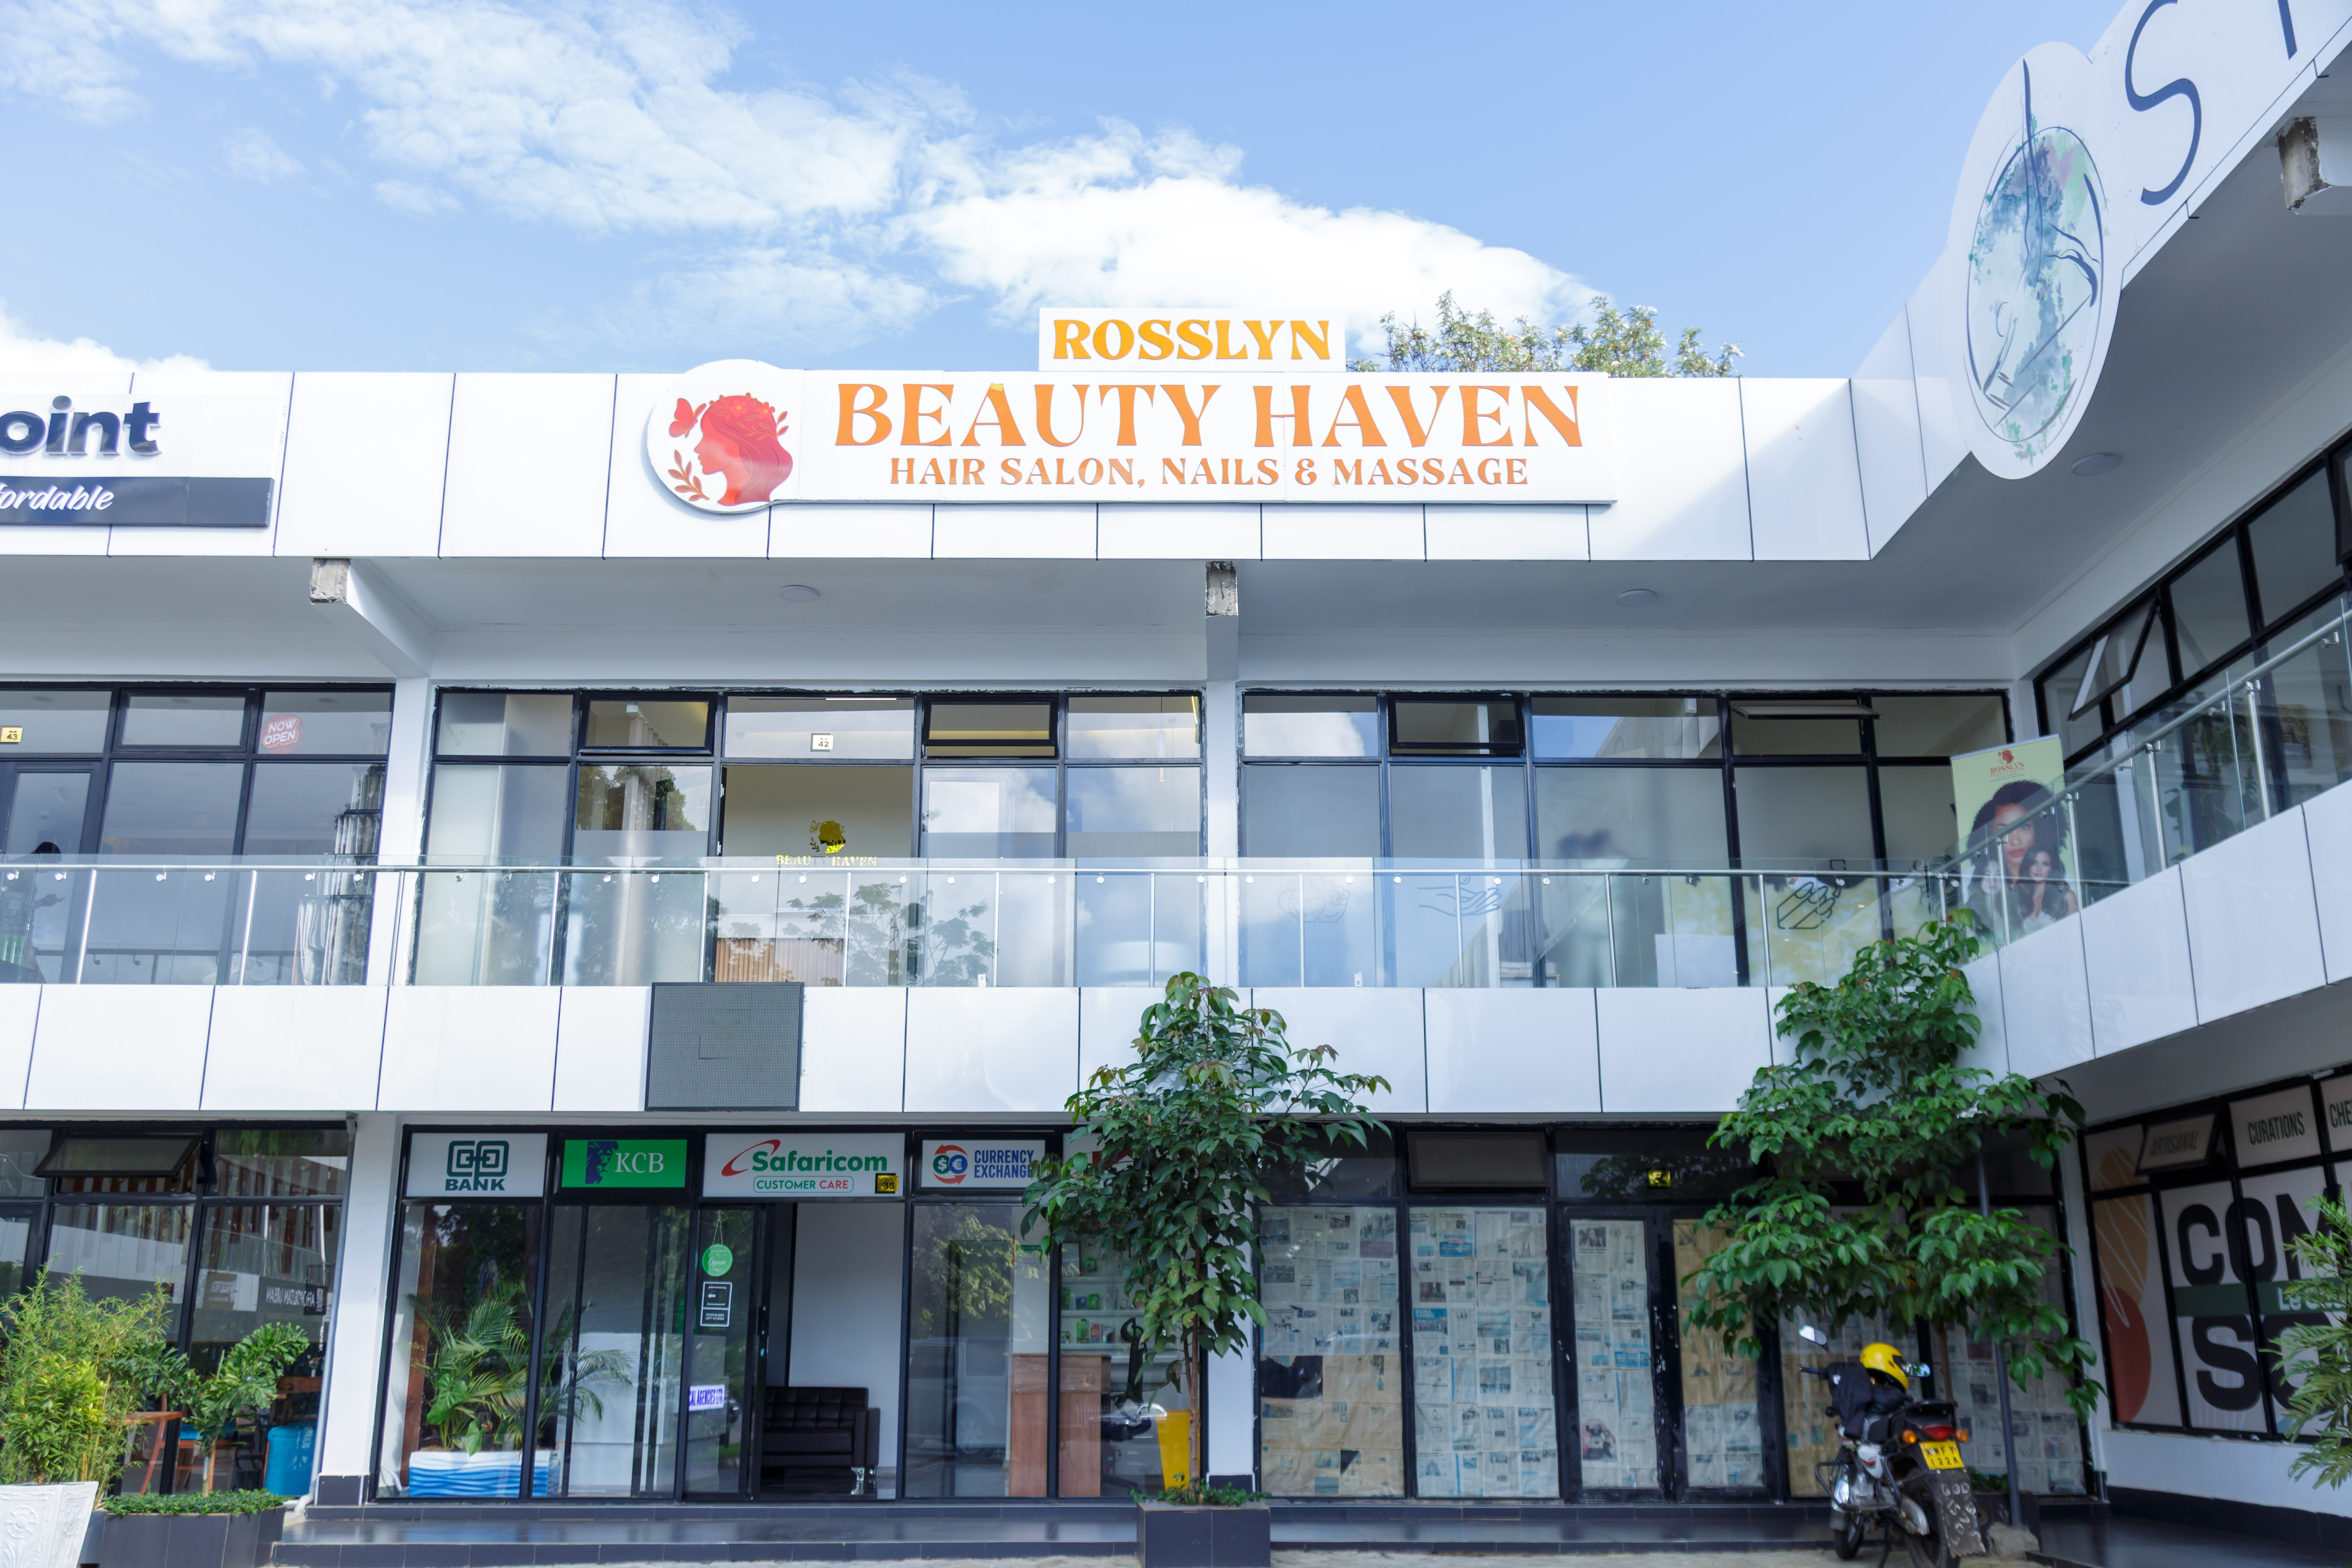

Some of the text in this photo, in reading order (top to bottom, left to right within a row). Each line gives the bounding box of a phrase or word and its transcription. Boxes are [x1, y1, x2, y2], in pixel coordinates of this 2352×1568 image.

[1053, 318, 1331, 361] ROSSLYN
[835, 383, 1583, 448] BEAUTY HAVEN
[0, 395, 162, 456] oint
[890, 458, 1528, 488] HAIR SALON, NAILS & MASSAGE
[268, 719, 297, 733] NOW
[264, 730, 296, 745] OPEN
[1990, 761, 2025, 774] ROSSLYN
[831, 856, 877, 866] HAVEN
[2247, 1111, 2305, 1145] CURATIONS
[614, 1152, 665, 1173] KCB
[751, 1149, 888, 1172] Safaricom
[974, 1150, 1035, 1164] CURRENCY
[445, 1178, 506, 1191] BANK
[757, 1180, 849, 1189] CUSTOMER CARE
[2178, 1183, 2352, 1287] COM
[708, 1258, 726, 1267] Open
